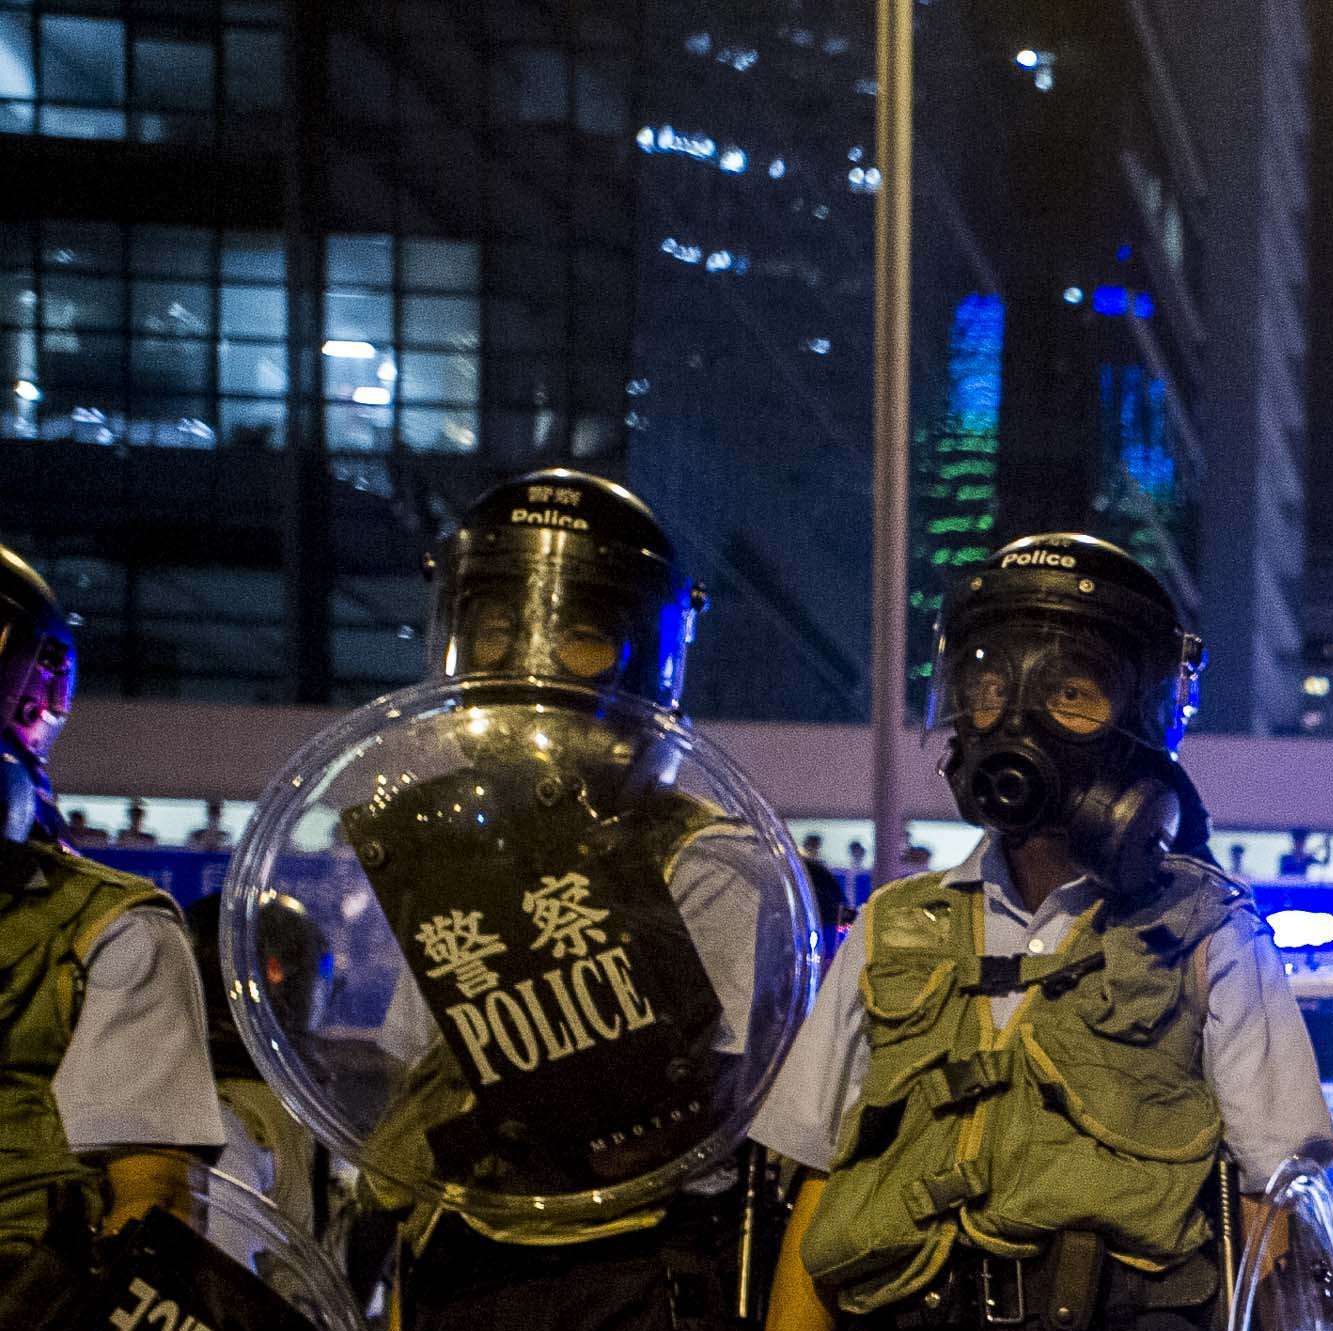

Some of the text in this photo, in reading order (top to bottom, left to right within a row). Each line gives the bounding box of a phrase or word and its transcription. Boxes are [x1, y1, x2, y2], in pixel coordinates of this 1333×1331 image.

[511, 507, 589, 531] Police
[1001, 550, 1077, 569] Police
[415, 871, 609, 998] 警察
[446, 946, 656, 1086] POLICE
